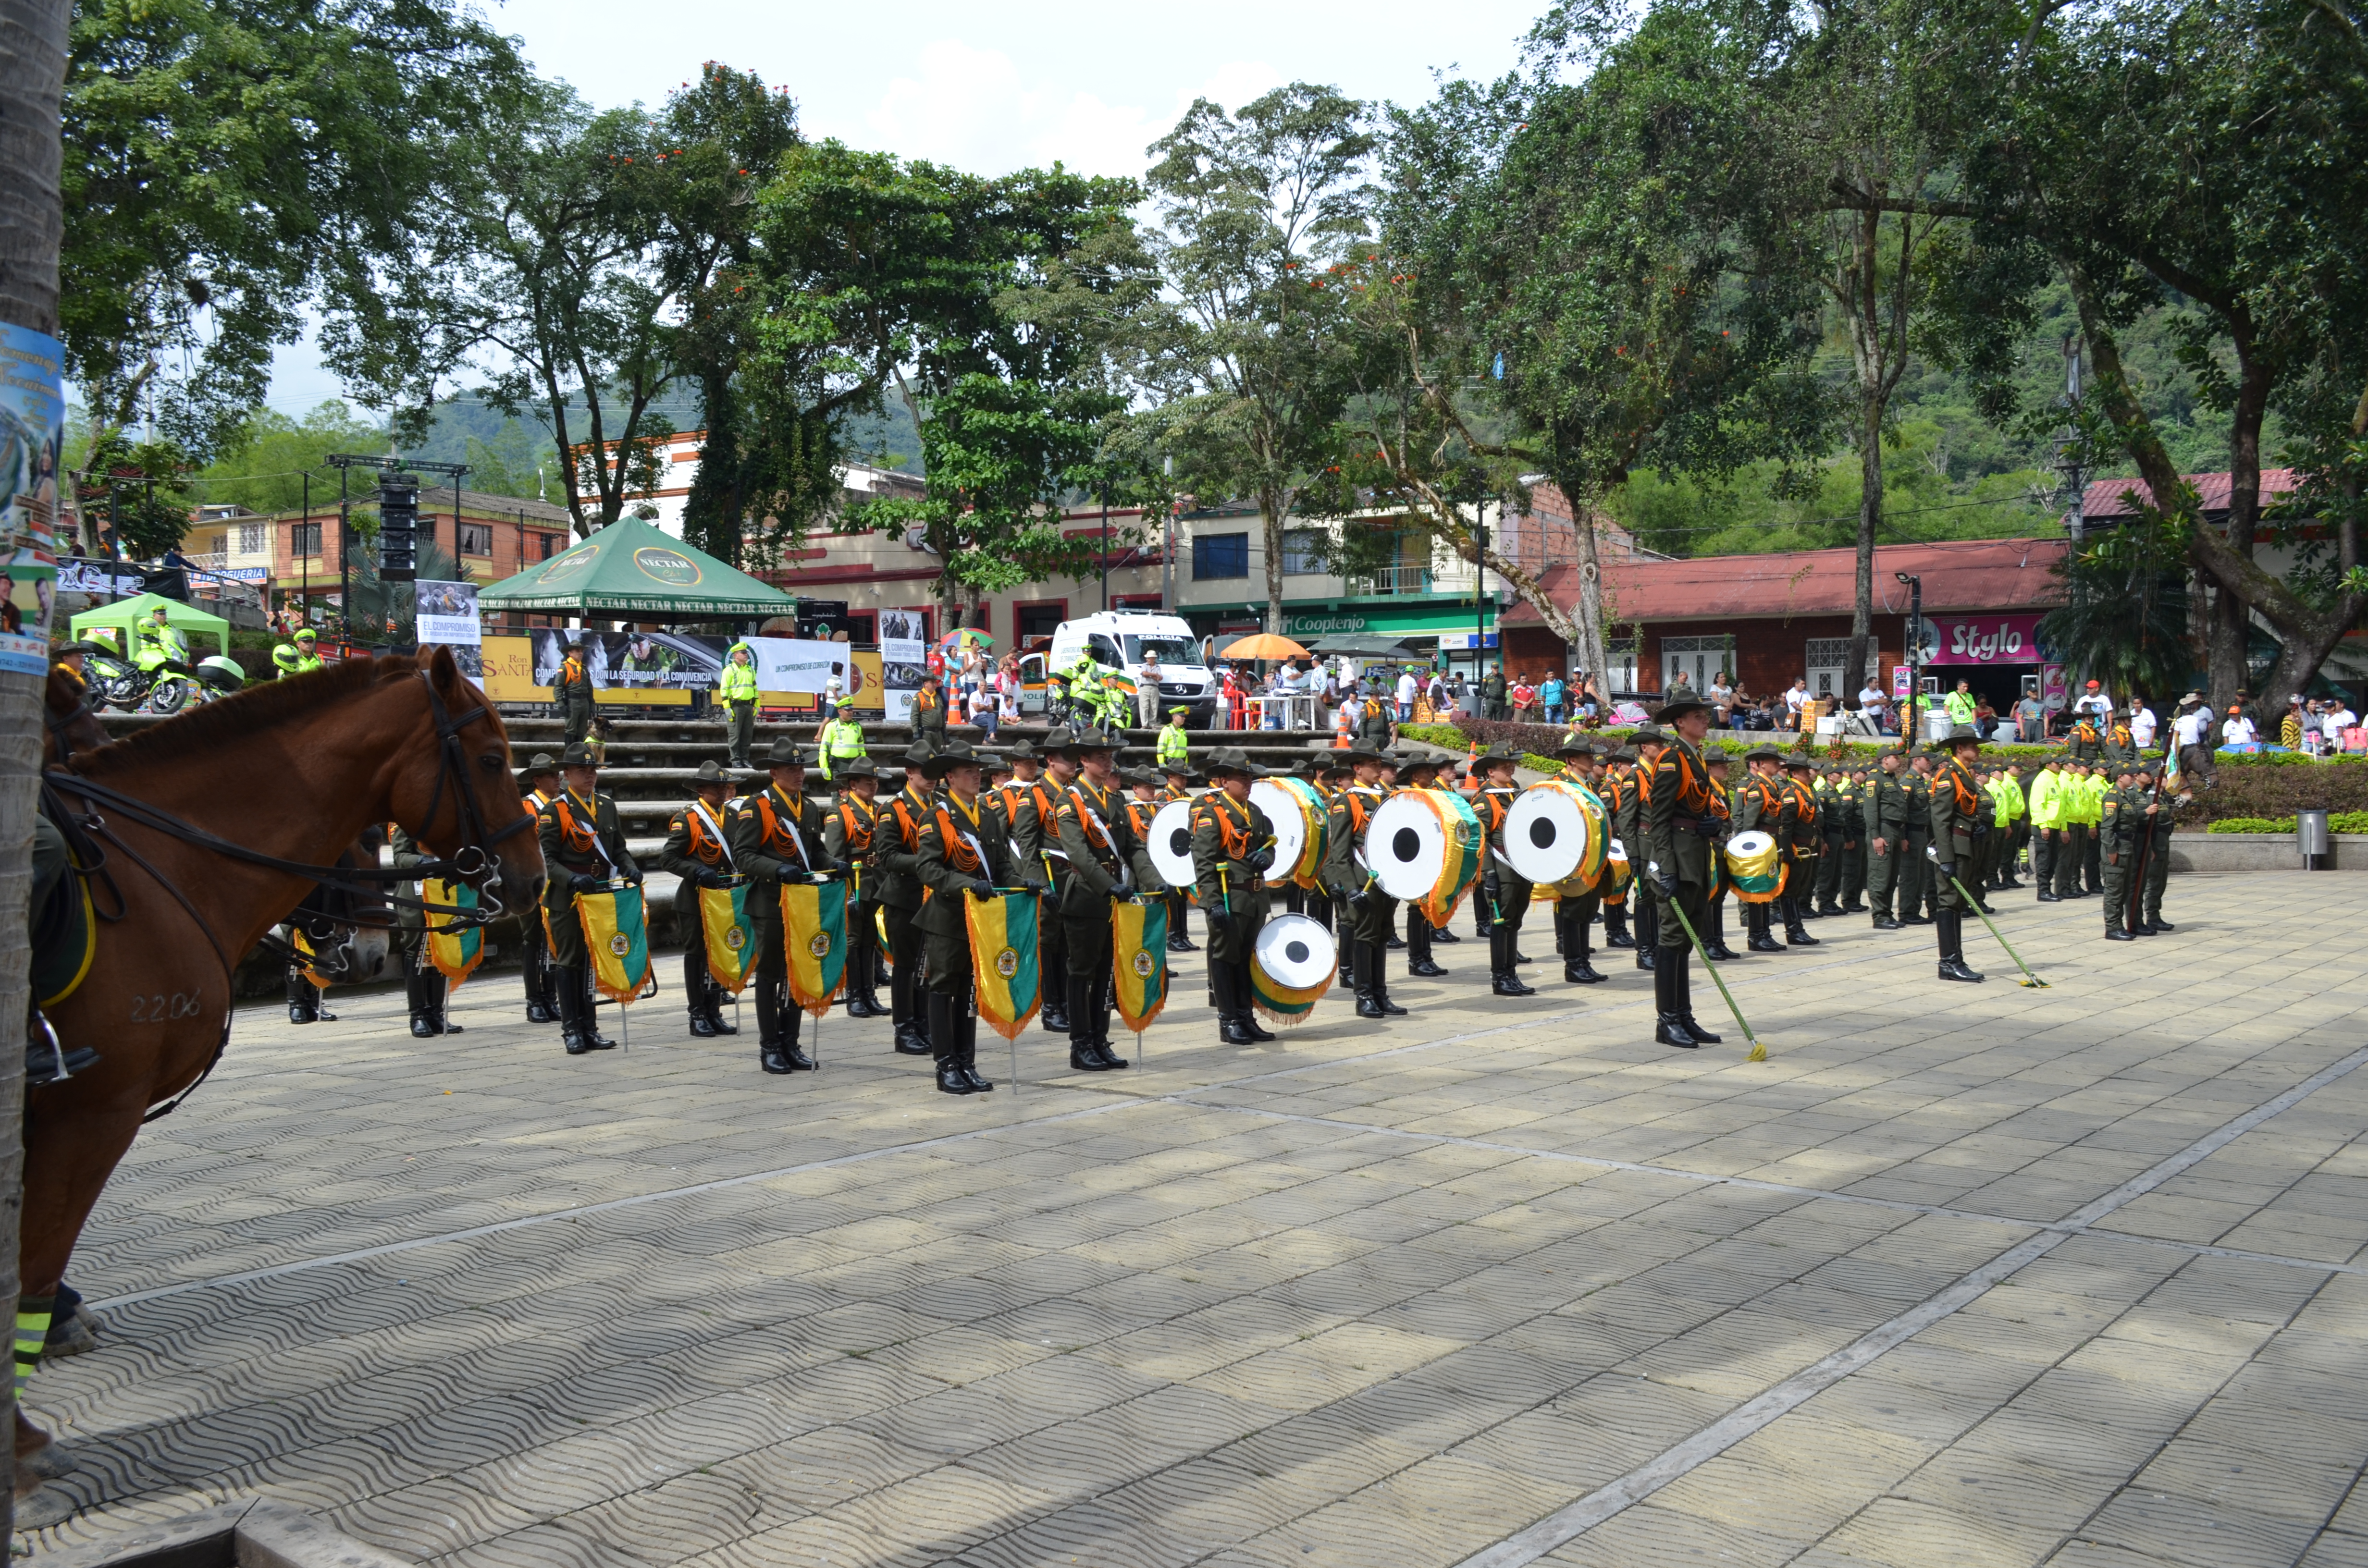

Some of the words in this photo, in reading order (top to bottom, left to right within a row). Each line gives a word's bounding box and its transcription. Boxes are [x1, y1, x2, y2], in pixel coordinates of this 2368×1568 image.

[639, 558, 691, 568] NECTAR
[586, 597, 628, 609] NECTAR
[631, 600, 671, 611] NECTAR
[675, 601, 714, 612] NECTAR
[717, 602, 755, 613] NECTAR
[758, 604, 795, 614] NECTAR
[424, 621, 432, 630] EL
[433, 622, 475, 633] COMPROMISO
[1295, 614, 1365, 633] Cooptenjo
[1951, 623, 2022, 661] Stylo
[891, 644, 921, 653] COMPROMISO
[508, 654, 528, 663] Ron
[781, 663, 807, 672] COMPROMISO
[596, 670, 608, 679] CON
[609, 670, 618, 679] LA
[619, 670, 655, 681] SEGURIDAD
[656, 671, 660, 680] Y
[662, 672, 670, 681] LA
[671, 672, 712, 682] CONVIVENCIA
[130, 987, 201, 1022] 2206
